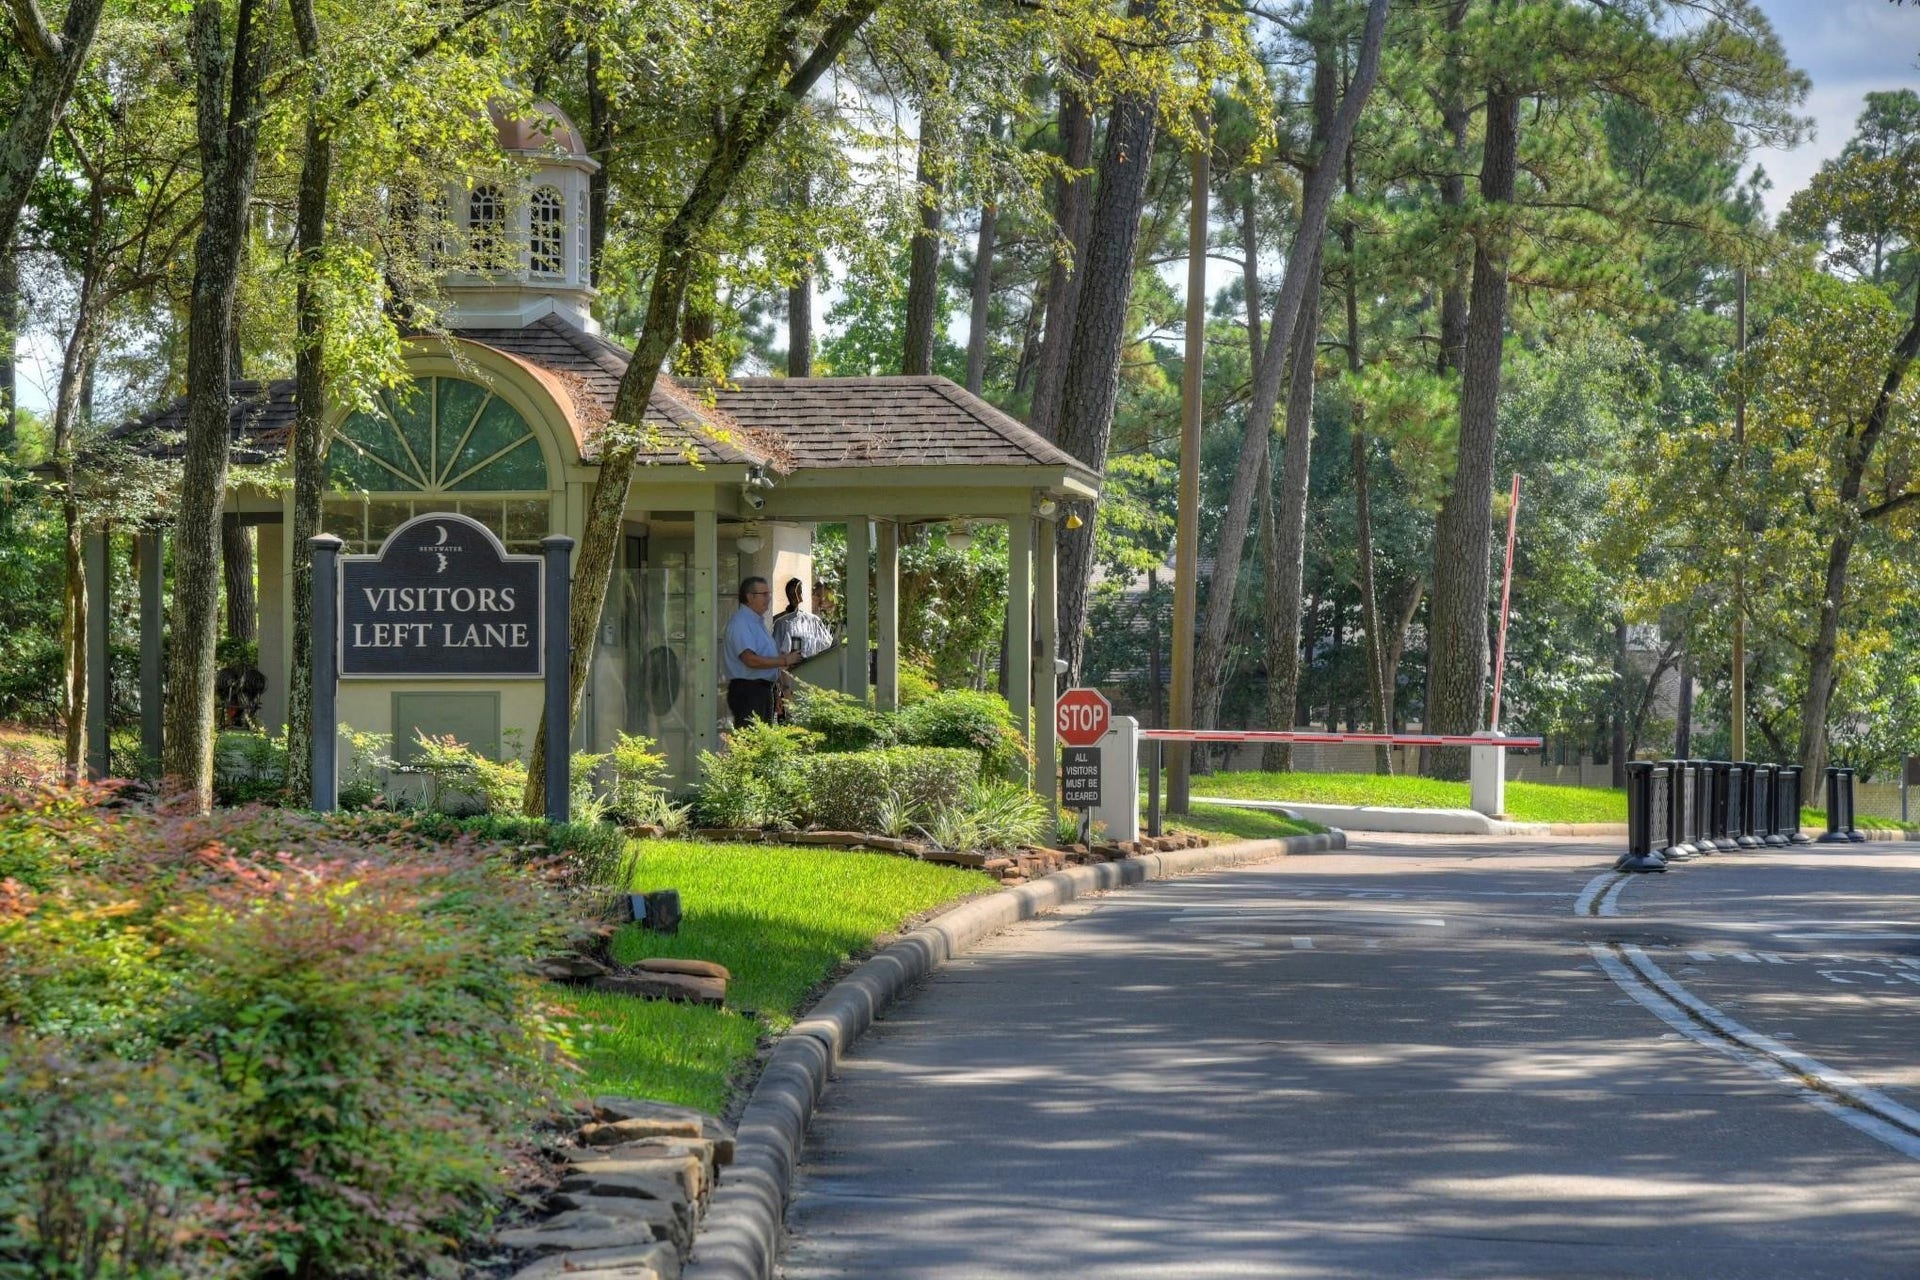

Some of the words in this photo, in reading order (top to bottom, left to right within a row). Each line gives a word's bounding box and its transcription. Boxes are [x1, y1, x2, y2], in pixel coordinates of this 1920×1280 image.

[362, 587, 516, 612] VISITORS
[352, 623, 433, 648] LEFT
[442, 623, 529, 648] LANE
[1059, 704, 1104, 731] STOP
[1075, 753, 1088, 762] ALL
[1066, 766, 1098, 775] VISITORS
[1066, 779, 1085, 788] MUST
[1088, 779, 1098, 788] BE
[1065, 791, 1098, 801] CLEARED
